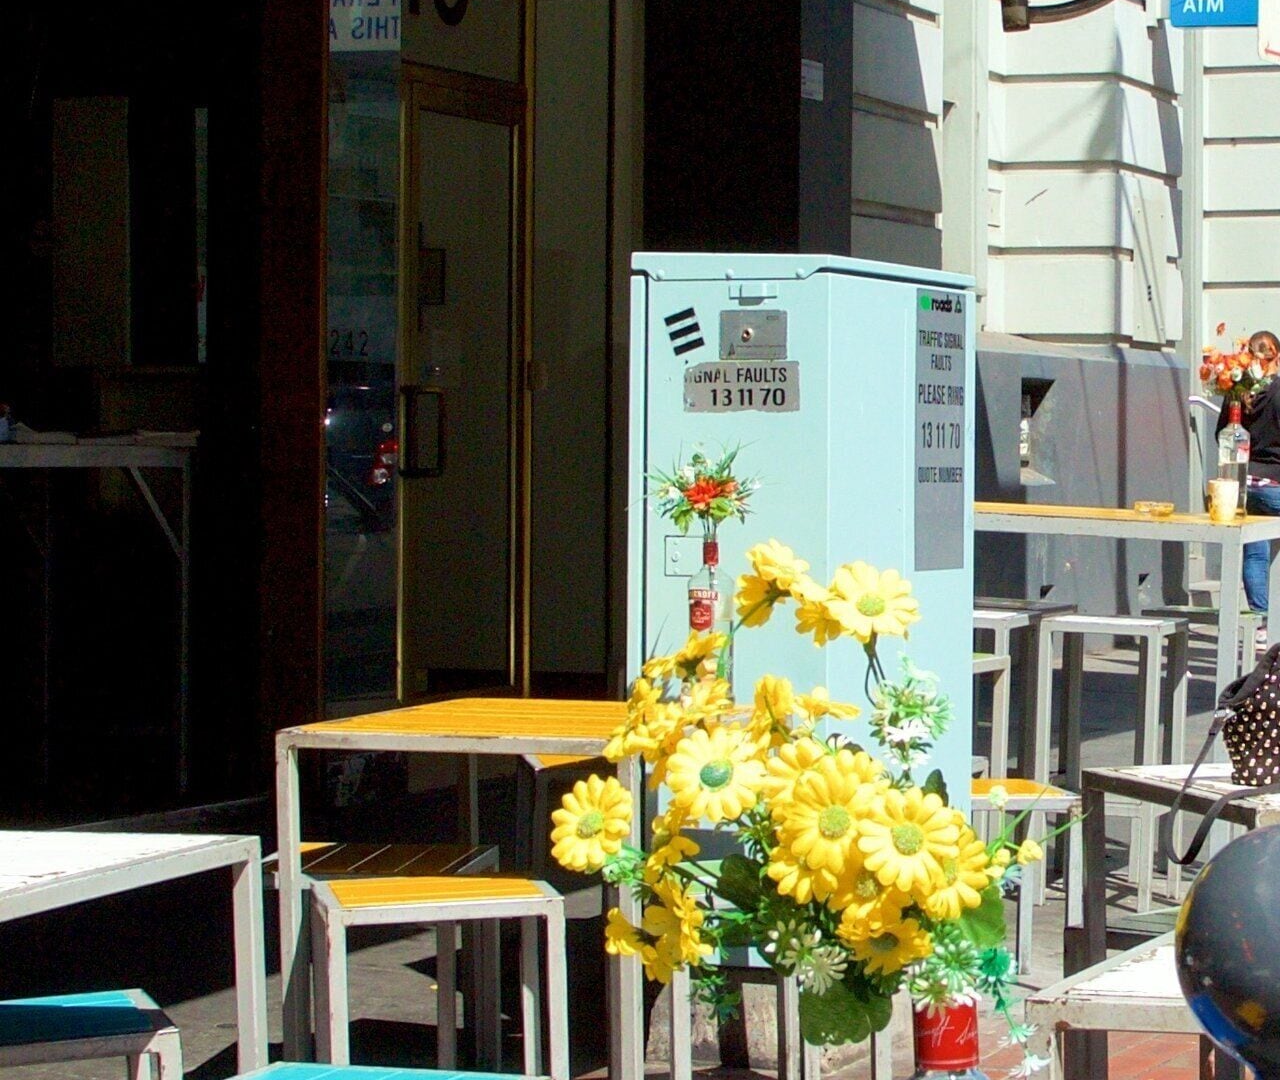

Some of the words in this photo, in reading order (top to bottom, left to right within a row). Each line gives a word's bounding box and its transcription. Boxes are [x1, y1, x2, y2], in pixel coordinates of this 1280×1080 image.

[918, 329, 943, 347] TRAFFIC
[943, 331, 964, 350] SIGNAL
[931, 353, 952, 372] FAULTS
[736, 367, 787, 383] FAULTS
[710, 388, 732, 407] 13
[738, 388, 754, 406] 11
[761, 387, 786, 406] 70
[918, 384, 947, 405] PLEASE
[947, 385, 964, 407] RING
[922, 422, 933, 449] 13
[935, 422, 946, 449] 11
[949, 423, 961, 450] 70
[918, 467, 938, 483] QUOTE
[938, 467, 963, 483] NUMBER
